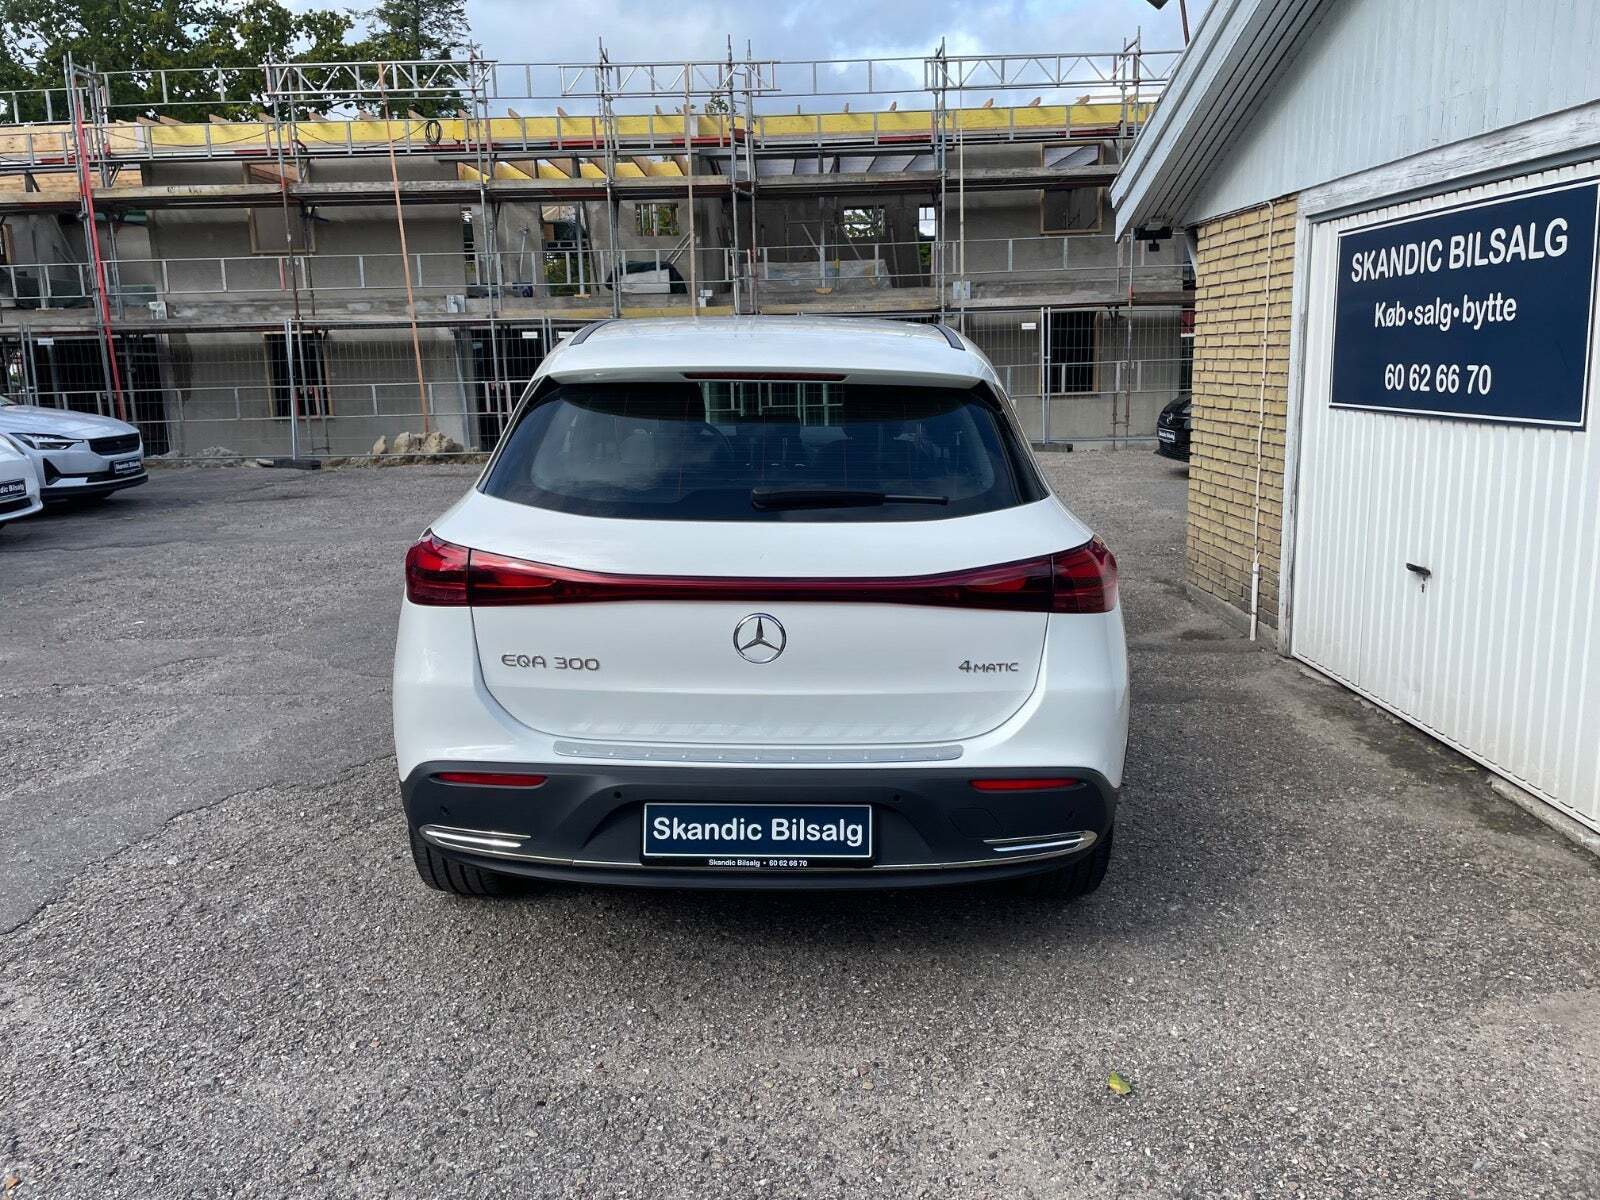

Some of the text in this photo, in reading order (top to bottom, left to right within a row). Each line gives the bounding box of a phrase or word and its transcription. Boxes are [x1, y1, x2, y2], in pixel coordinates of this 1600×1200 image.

[1351, 217, 1568, 283] SKANDIC BILSALG
[1384, 363, 1492, 395] 60 62 66 70
[501, 654, 601, 671] EQA 300
[652, 816, 863, 847] Skandic Bilsalg
[737, 859, 760, 868] Bilsalg
